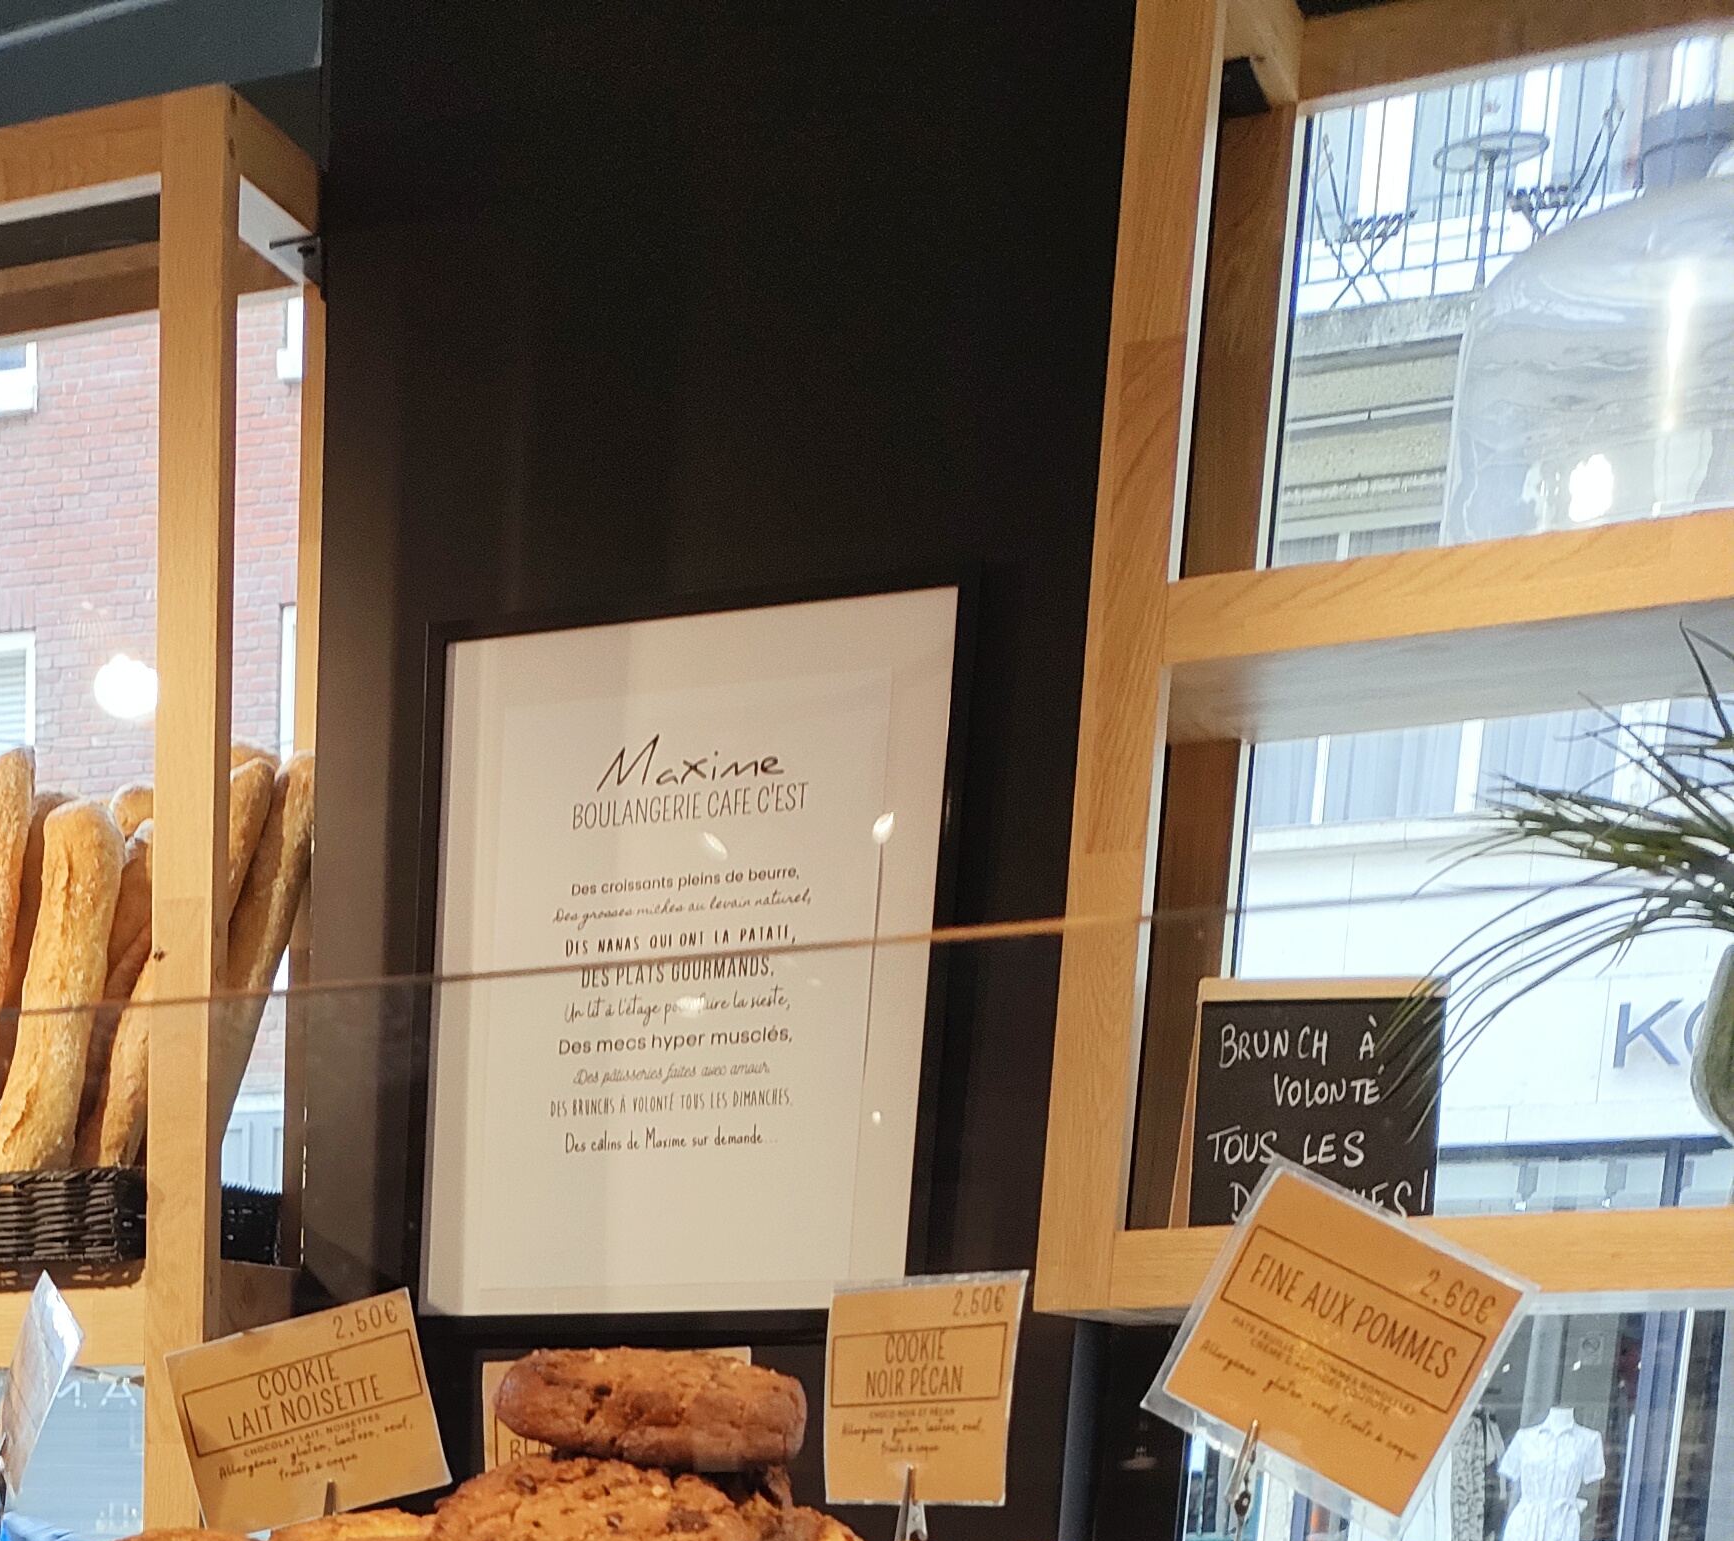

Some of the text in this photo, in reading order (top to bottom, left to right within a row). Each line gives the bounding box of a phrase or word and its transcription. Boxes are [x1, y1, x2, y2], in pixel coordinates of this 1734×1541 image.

[596, 733, 784, 792] Maxime
[572, 782, 809, 830] BOULANGERIE CAFE C'EST
[571, 866, 800, 896] Des croissants pleins de beurre,
[553, 908, 578, 923] Des
[709, 896, 751, 911] levain
[598, 935, 640, 953] NANAS
[649, 934, 672, 949] QUI
[680, 931, 704, 947] ONT
[714, 929, 729, 945] LA
[581, 966, 610, 989] DES
[616, 963, 665, 986] PLATS
[565, 1001, 584, 1023] Un
[587, 996, 603, 1018] lit
[733, 990, 749, 1009] la
[750, 984, 791, 1011] sieste,
[559, 1024, 793, 1057] Des mecs hyper musclés,
[1219, 1014, 1377, 1069] BRUNCH À
[573, 1068, 599, 1085] Des
[601, 1066, 663, 1087] pâtisseries
[662, 1062, 696, 1085] faites
[1273, 1064, 1385, 1108] VOLONTÉ
[550, 1101, 568, 1118] DES
[572, 1098, 615, 1116] BRUNCHS
[632, 1091, 675, 1113] VOLONTÉ
[681, 1092, 705, 1111] TOUS
[710, 1091, 728, 1109] LES
[565, 1132, 586, 1154] Des
[590, 1130, 622, 1152] câlins
[627, 1129, 640, 1150] de
[645, 1127, 687, 1149] Maxime
[692, 1135, 709, 1147] sur
[1207, 1125, 1365, 1169] TOUS LES
[1249, 1253, 1304, 1302] FINE
[1305, 1280, 1355, 1327] AUX
[1353, 1304, 1457, 1380] POMMES
[885, 1331, 946, 1364] COOKIE
[257, 1355, 340, 1400] COOKIE
[866, 1364, 963, 1399] NOIR PÉCAN
[228, 1374, 384, 1441] LAIT NOISETTE
